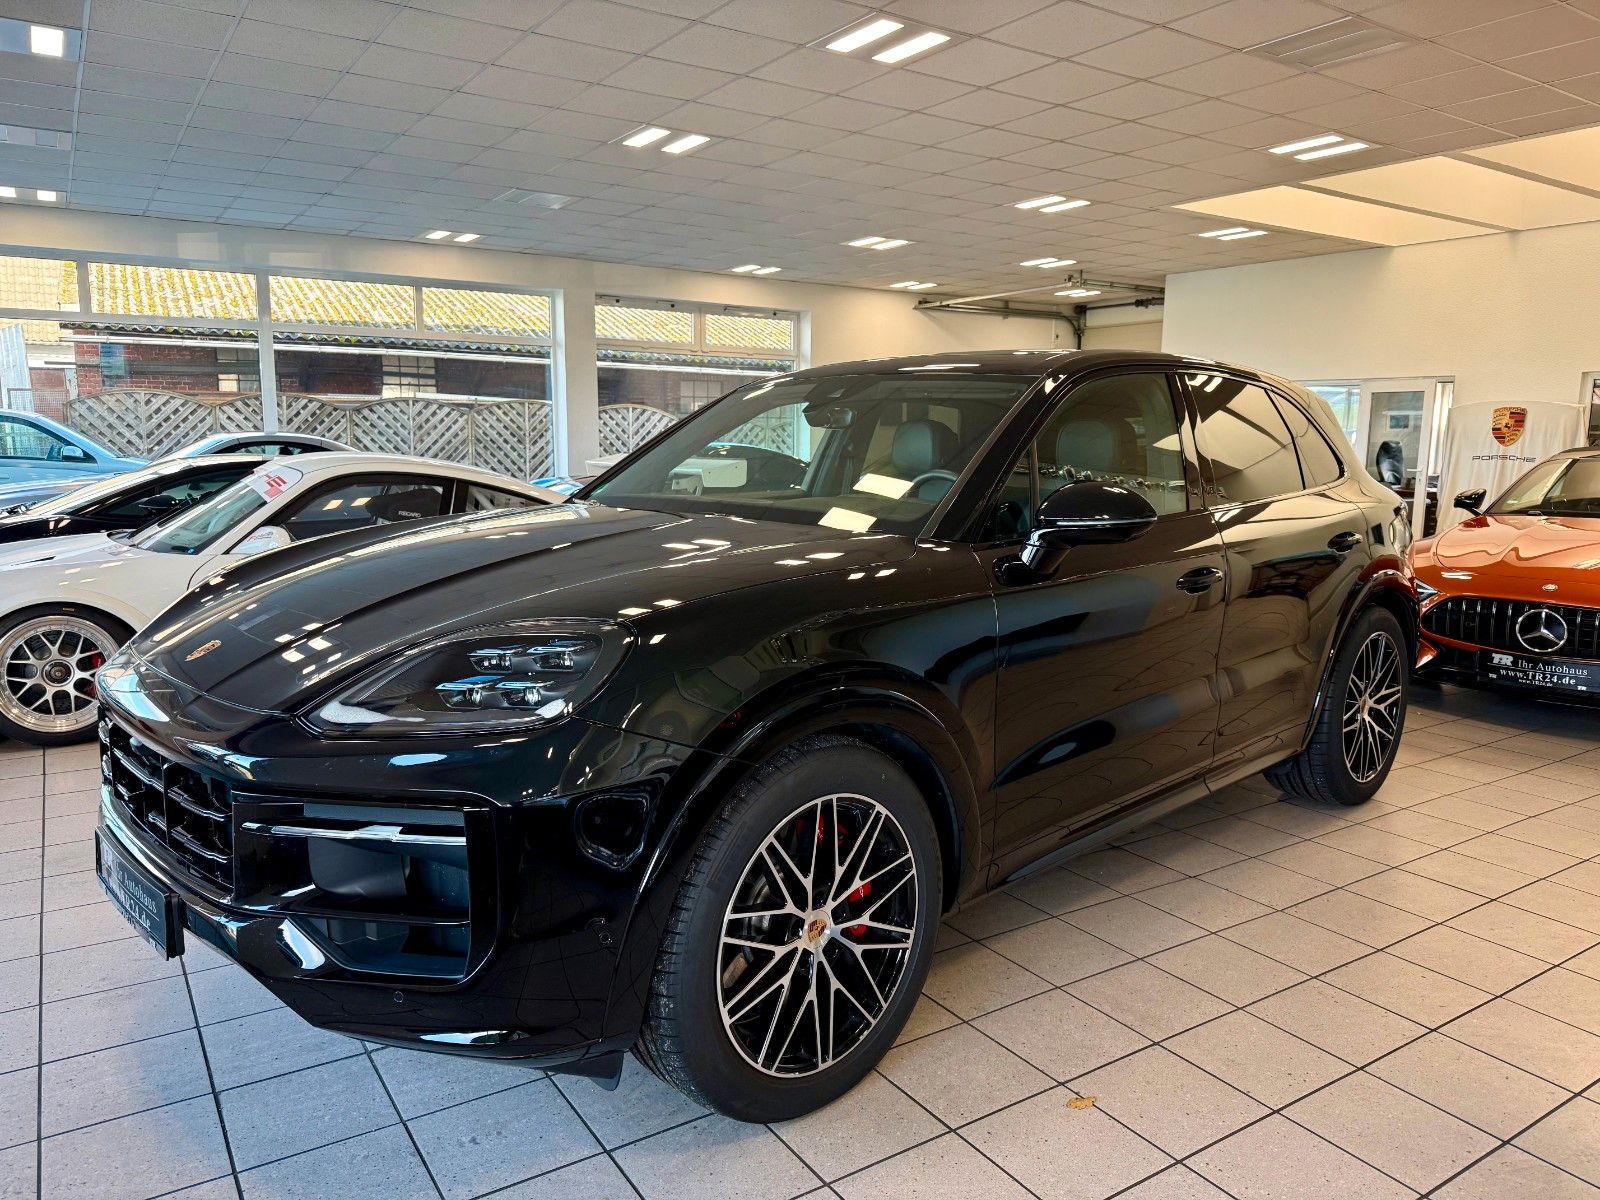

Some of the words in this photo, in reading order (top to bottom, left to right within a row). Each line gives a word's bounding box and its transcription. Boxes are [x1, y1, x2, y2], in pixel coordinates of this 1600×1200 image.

[1472, 454, 1537, 463] PORSCHE
[1518, 659, 1534, 669] Ihr
[1536, 662, 1588, 676] Autohaus
[1500, 669, 1576, 685] www.TR24.de
[124, 875, 157, 914] Autohaus
